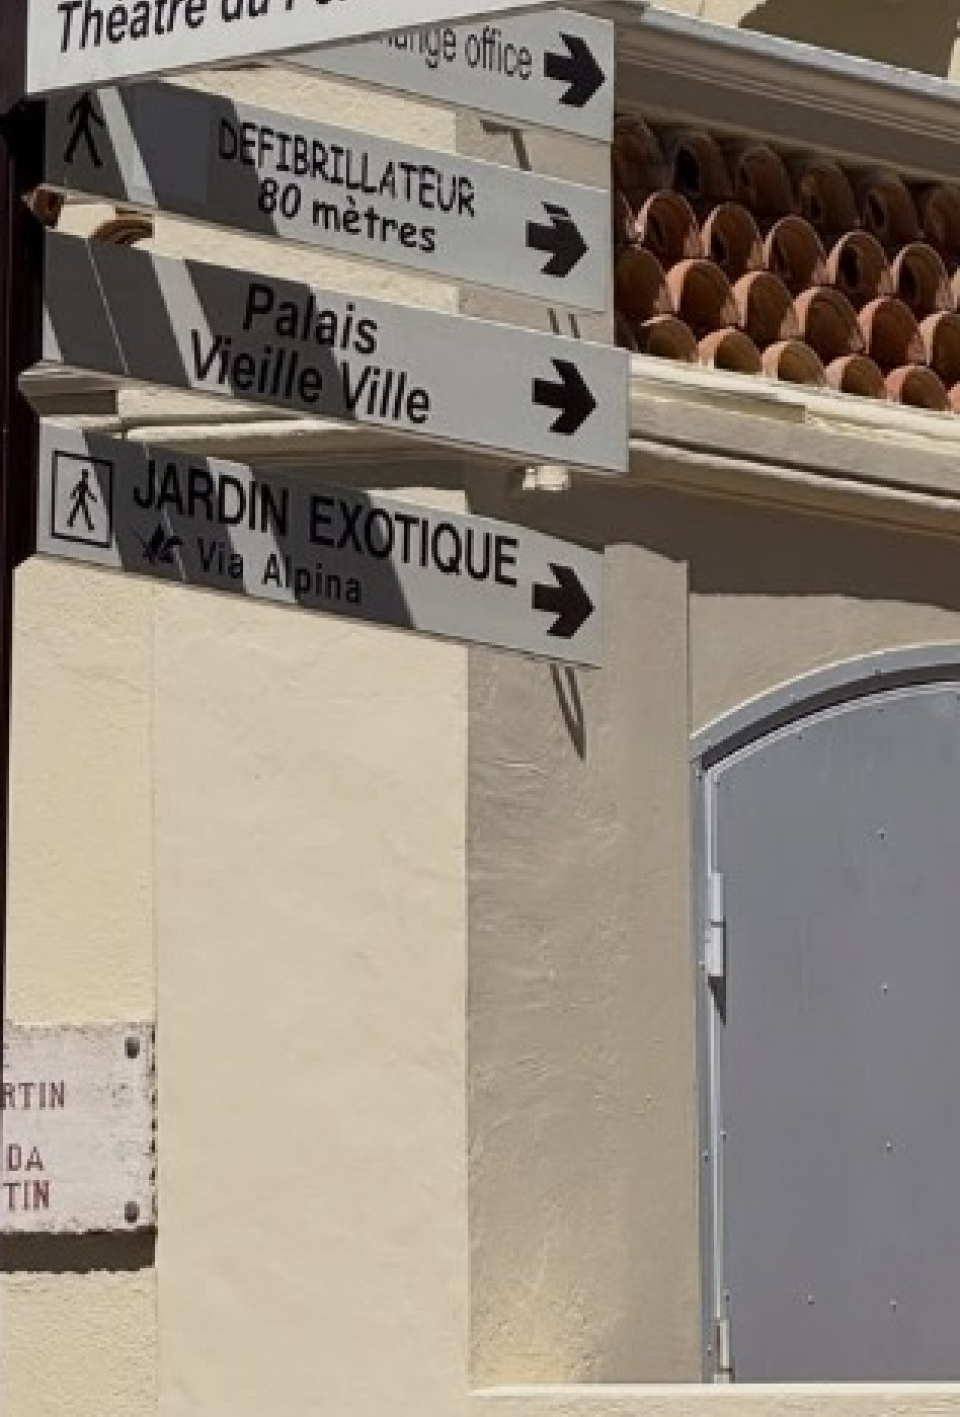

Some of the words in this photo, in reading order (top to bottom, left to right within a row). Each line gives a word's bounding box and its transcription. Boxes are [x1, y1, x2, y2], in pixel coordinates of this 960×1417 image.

[465, 25, 532, 80] office
[218, 118, 474, 218] DEFIBRILLATEUR
[257, 177, 302, 219] 80
[312, 194, 436, 253] mètres
[243, 283, 378, 355] Palais
[191, 329, 323, 403] Vieille
[342, 360, 430, 424] Ville
[133, 460, 288, 537] JARDIN
[309, 495, 519, 587] EXOTIQUE
[196, 537, 243, 580] Via
[262, 554, 362, 605] Alpina
